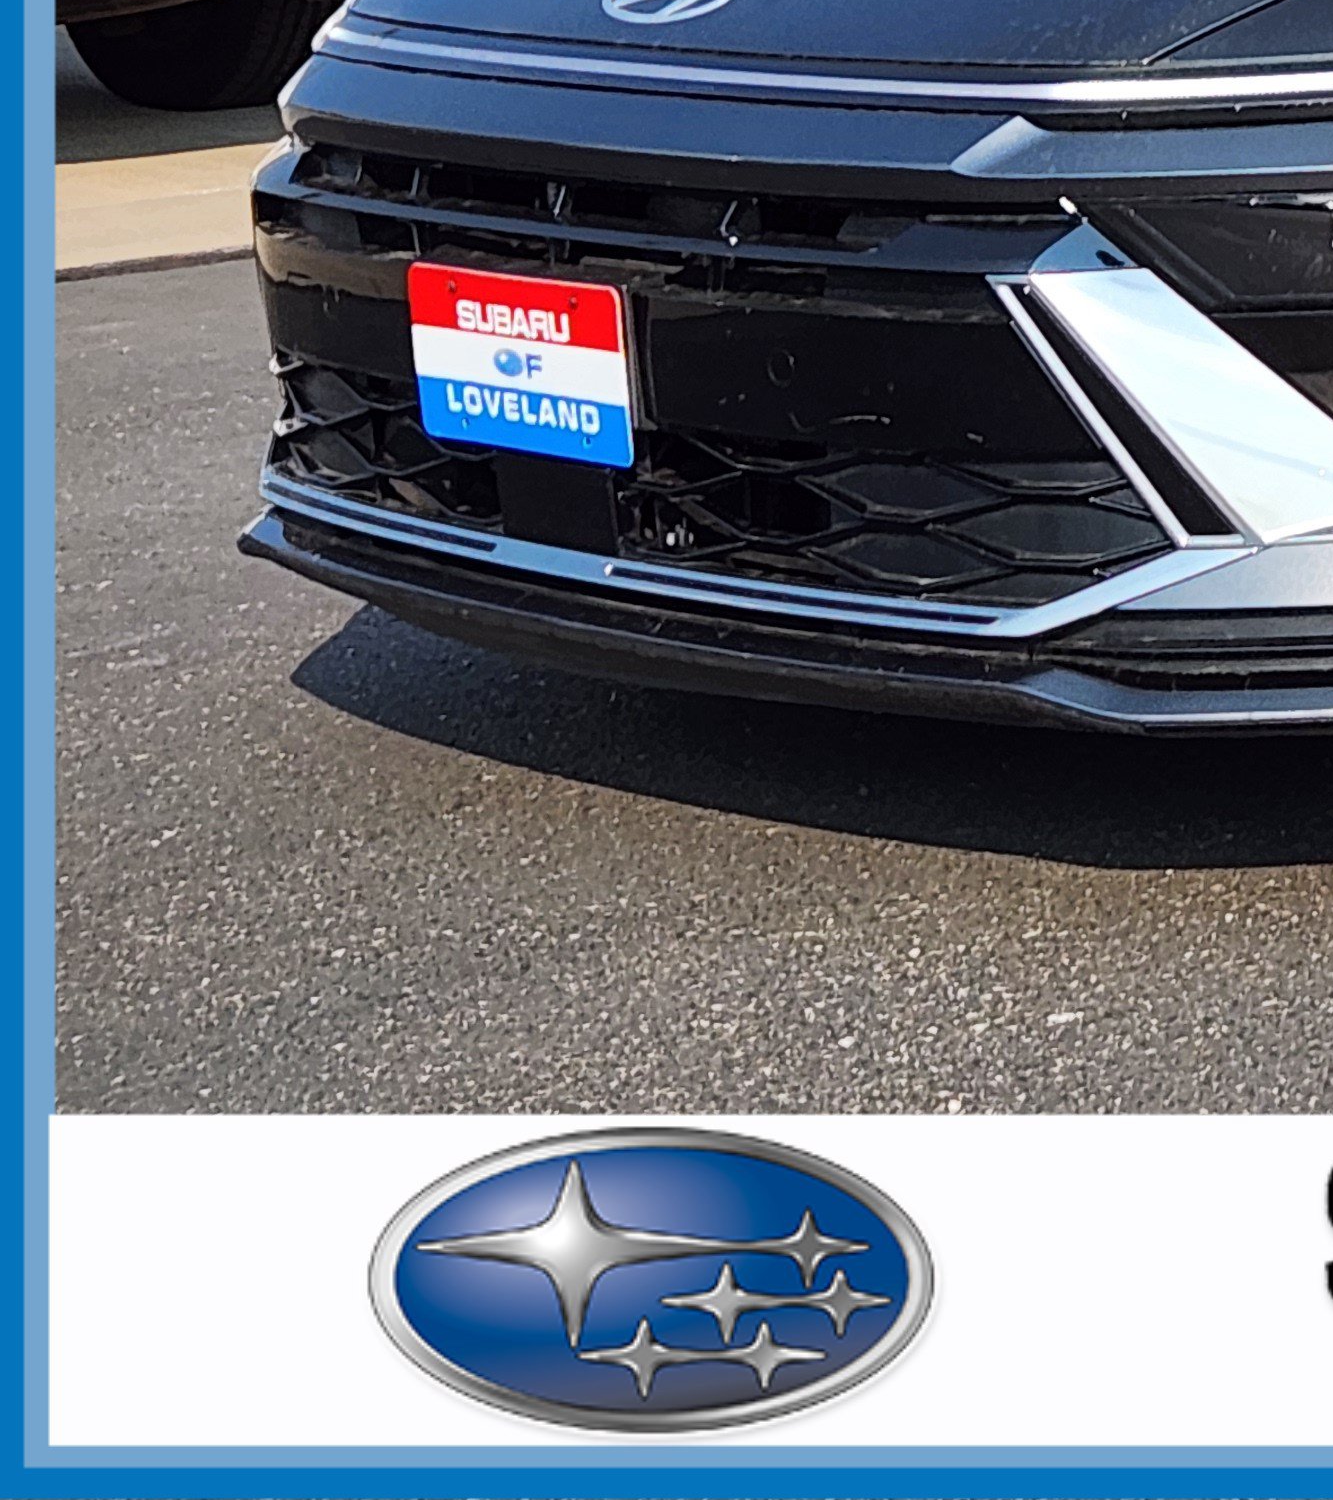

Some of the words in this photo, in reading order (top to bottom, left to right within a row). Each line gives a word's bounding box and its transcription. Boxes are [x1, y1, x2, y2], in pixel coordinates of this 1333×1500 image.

[455, 298, 571, 344] SUBARU
[494, 348, 543, 380] OF
[445, 382, 601, 436] LOVELAND
